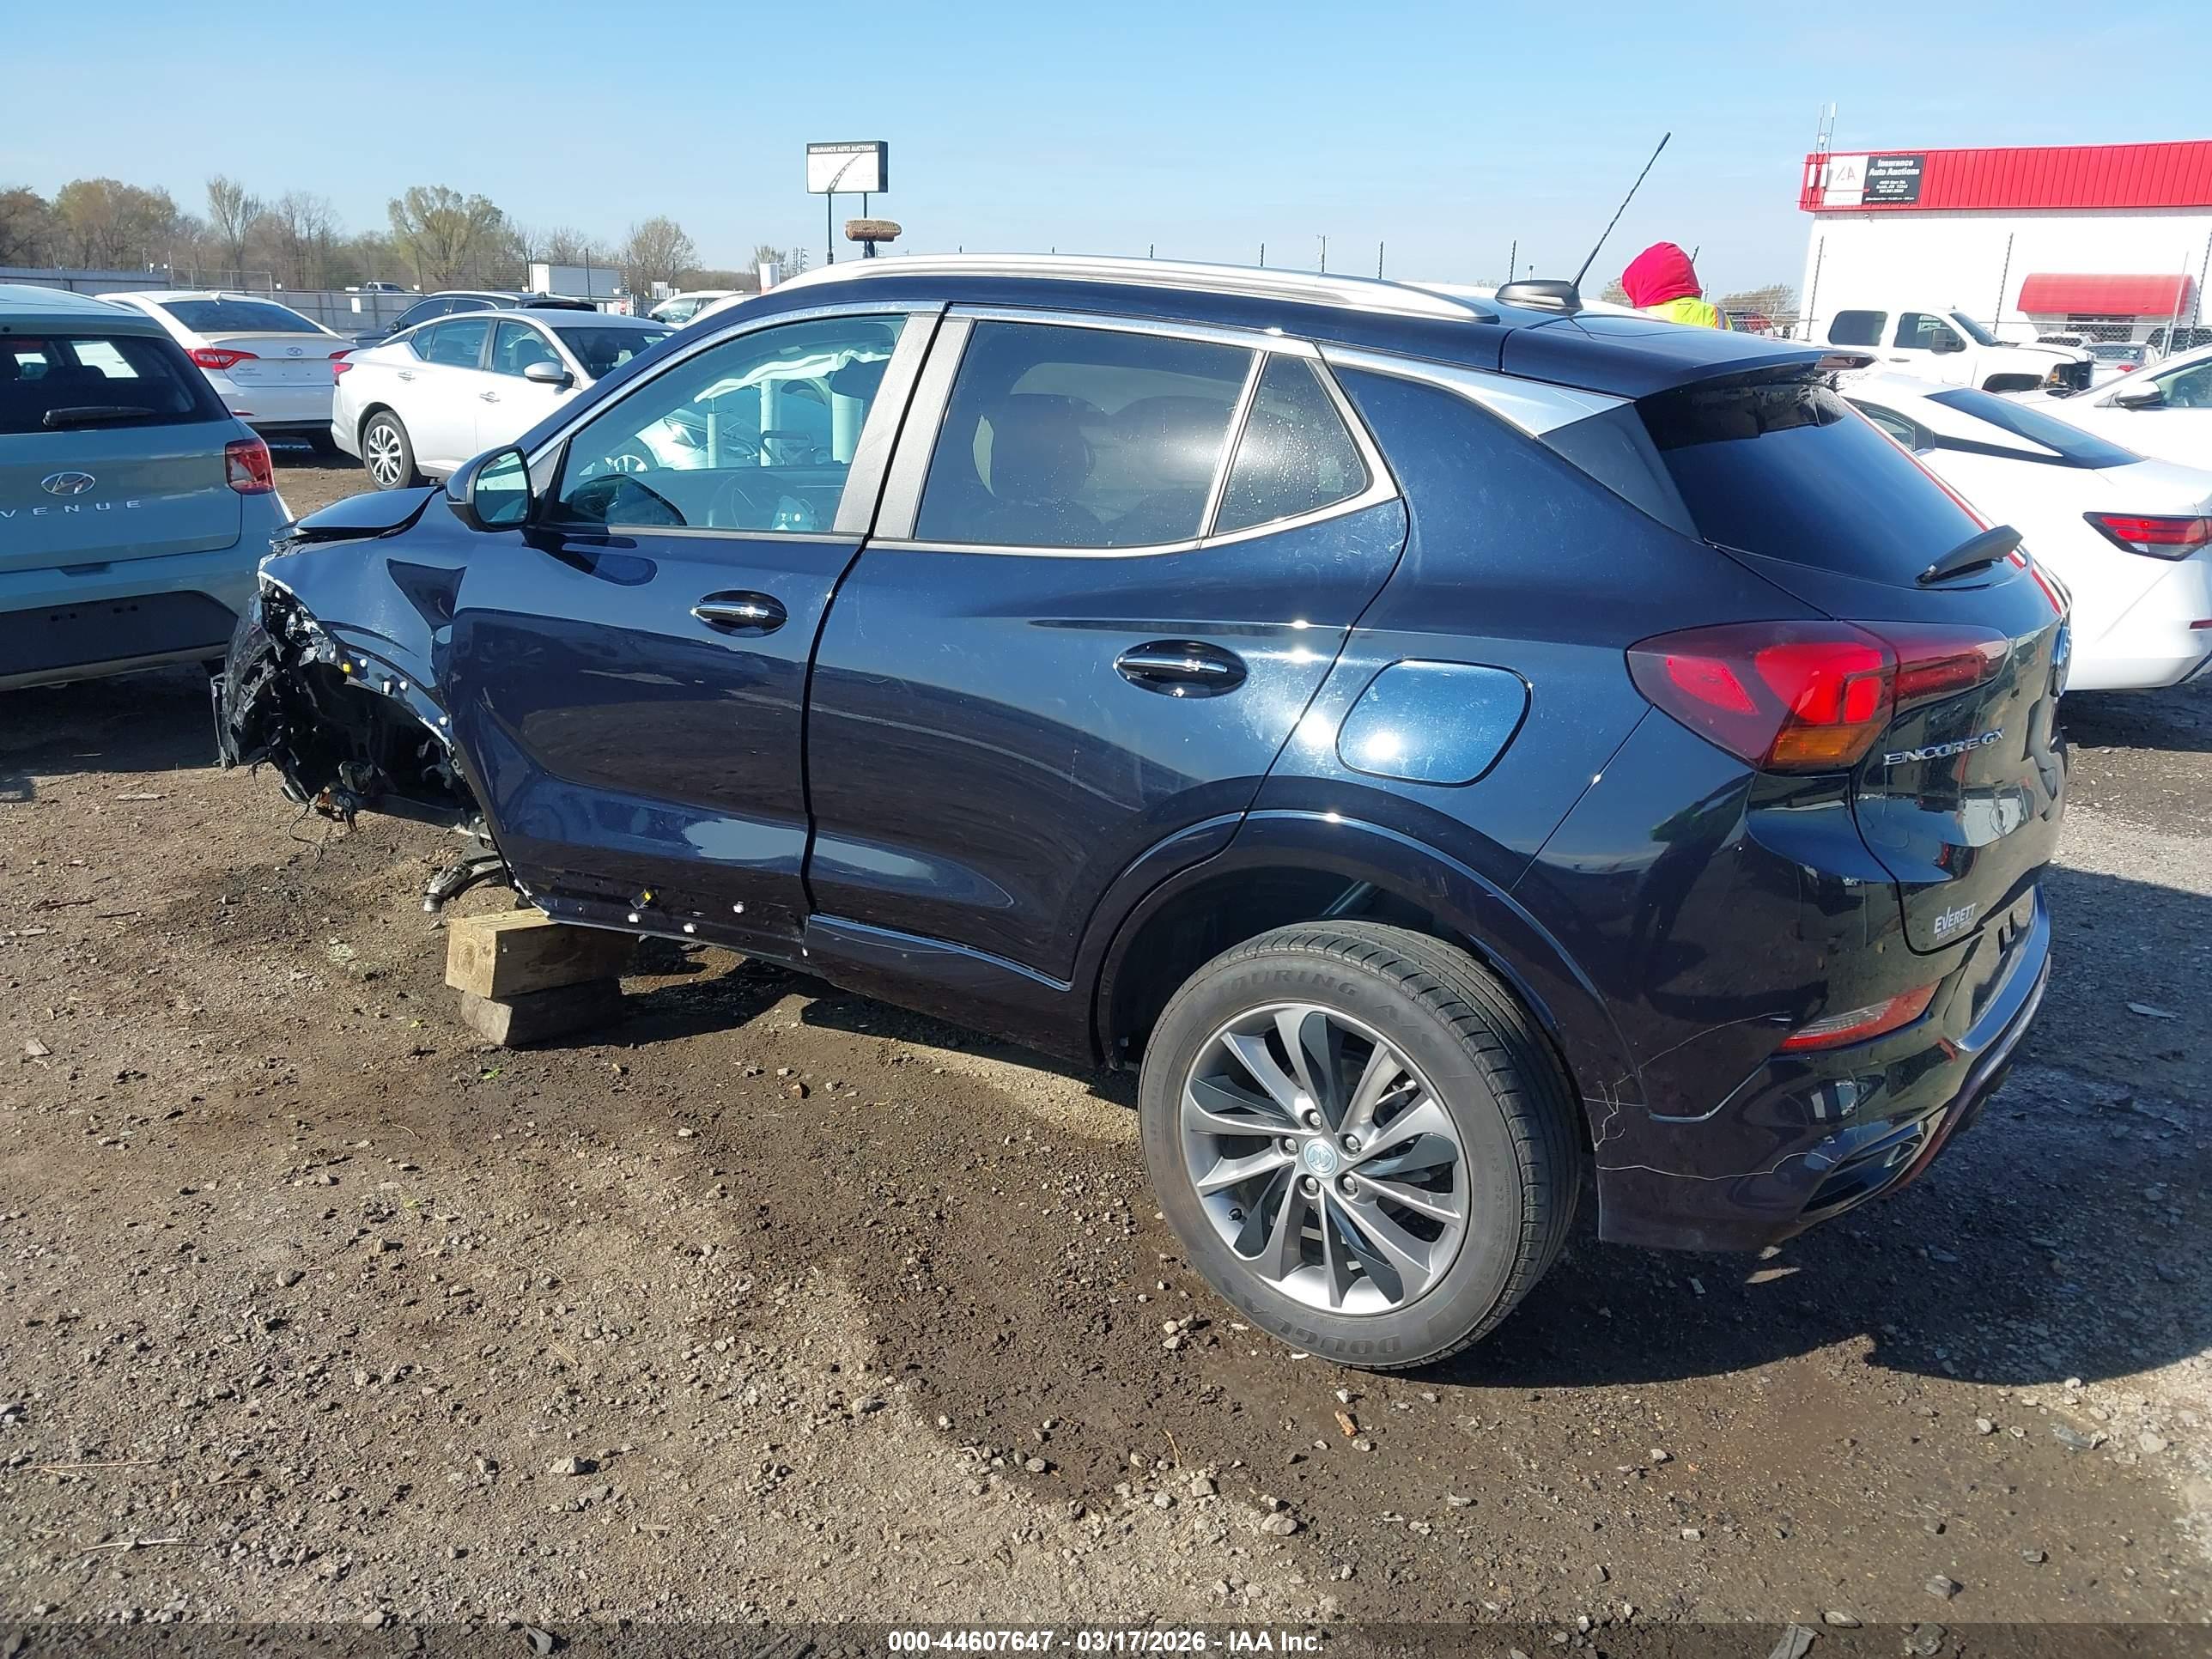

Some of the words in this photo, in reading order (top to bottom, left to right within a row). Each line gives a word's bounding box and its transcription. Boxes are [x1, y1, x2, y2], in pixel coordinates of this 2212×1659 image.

[1869, 167, 1886, 176] Auto
[1887, 167, 1920, 176] Auctions
[1877, 159, 1914, 167] Insurance
[0, 500, 142, 519] VENUE
[1883, 738, 1979, 766] ENCORE
[1980, 727, 2005, 745] GX
[1934, 902, 1978, 934] EVERETT
[1212, 969, 1359, 999] TOURING
